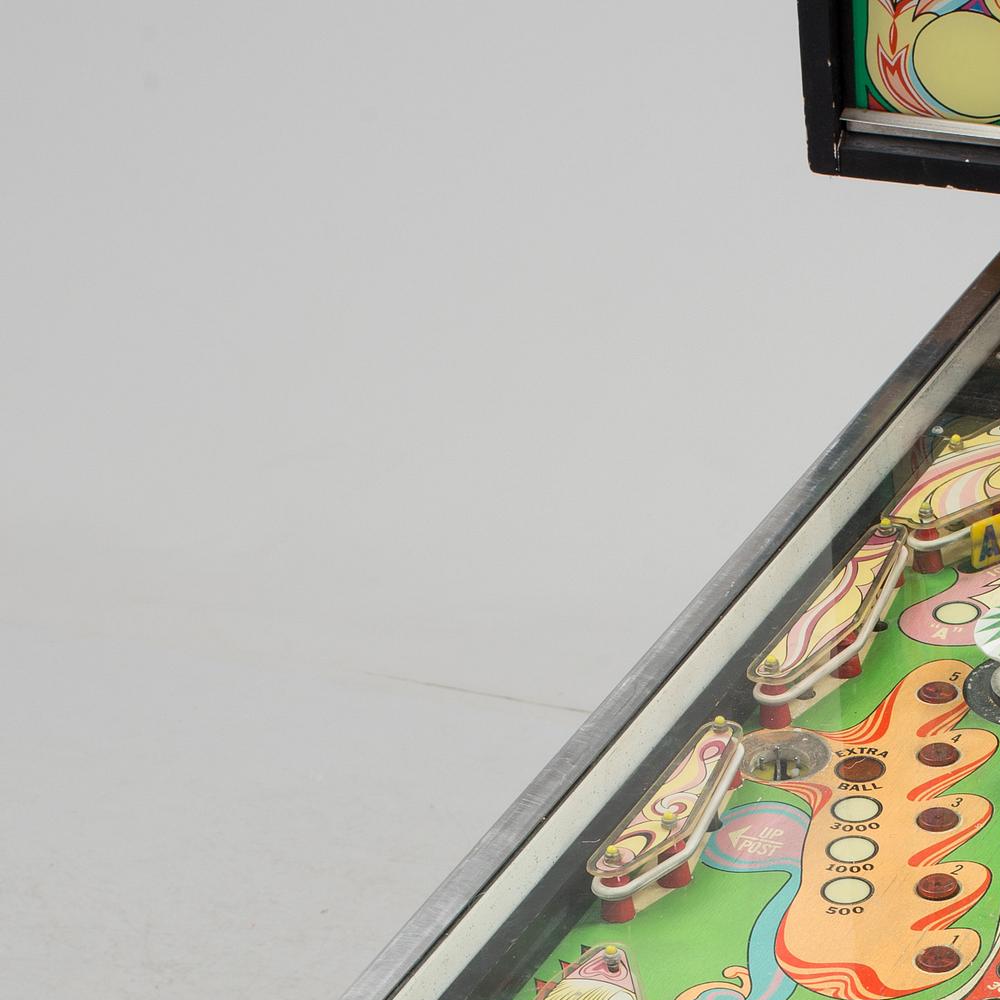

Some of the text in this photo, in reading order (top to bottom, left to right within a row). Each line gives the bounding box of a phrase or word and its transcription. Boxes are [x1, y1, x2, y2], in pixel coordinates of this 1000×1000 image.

[979, 524, 1000, 561] A
[948, 671, 962, 681] 5
[950, 733, 962, 744] 4
[834, 746, 890, 758] EXTRA
[836, 782, 885, 792] BALL
[951, 798, 963, 808] 3
[829, 822, 881, 832] 3000
[758, 827, 785, 839] UP
[737, 840, 785, 856] POST
[825, 863, 875, 873] 1000
[949, 865, 963, 876] 2
[825, 906, 865, 915] 500
[950, 935, 960, 945] 1
